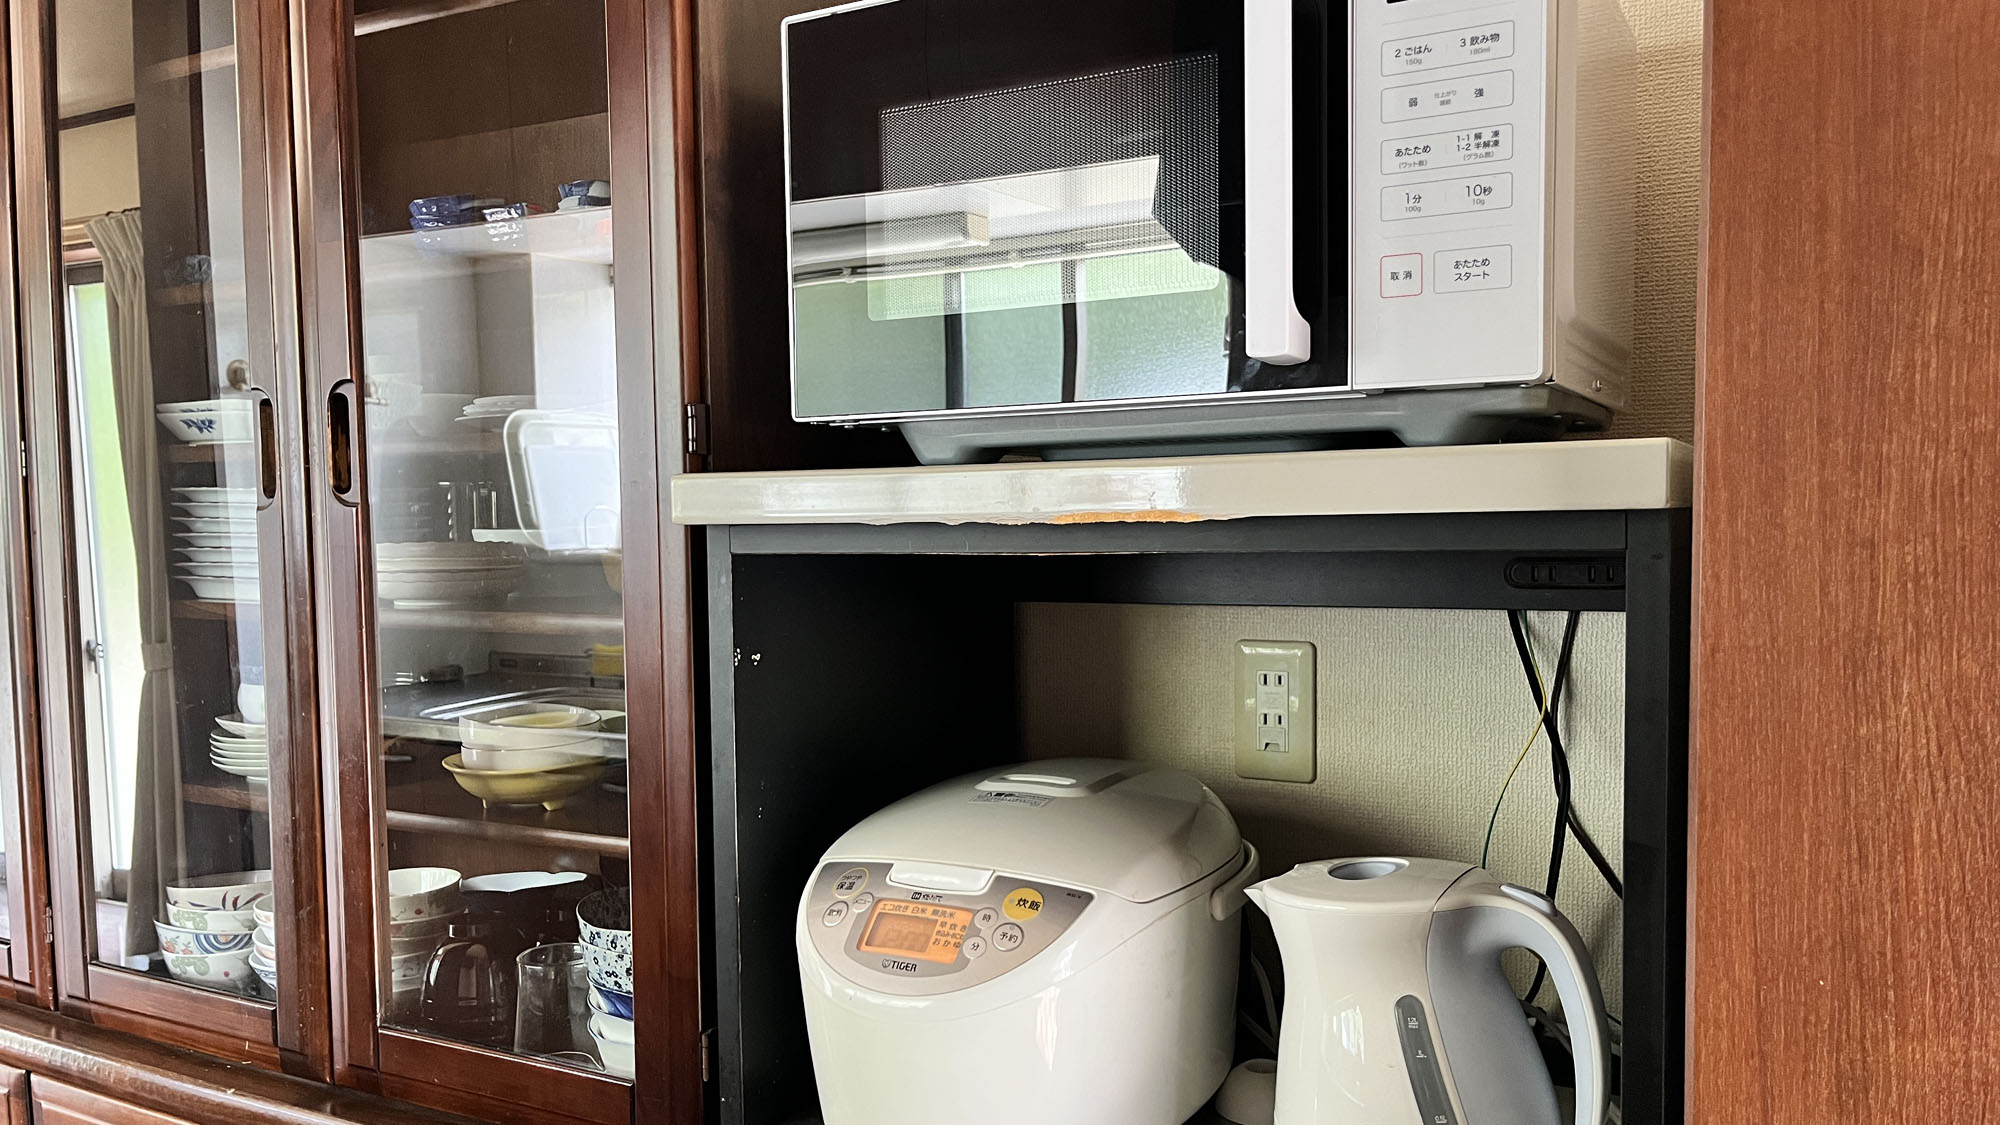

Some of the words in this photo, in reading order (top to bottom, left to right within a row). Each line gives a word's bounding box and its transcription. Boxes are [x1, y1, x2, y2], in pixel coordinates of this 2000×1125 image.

[1460, 38, 1466, 47] 3
[1470, 33, 1500, 46] 飲み物
[1395, 48, 1401, 58] 2
[1405, 44, 1432, 57] ごはん
[1405, 58, 1422, 66] 150g
[1474, 88, 1484, 97] 強
[1408, 97, 1418, 107] 弱
[1457, 134, 1470, 143] 1-1
[1394, 145, 1432, 158] あたため
[1457, 143, 1471, 152] 1-2
[1474, 139, 1500, 150] 半解凍
[1466, 184, 1493, 197] 10秒
[1405, 192, 1422, 205] 1分
[1472, 198, 1485, 207] 10g
[1405, 205, 1422, 214] 100g
[1453, 257, 1491, 270] あたため
[1454, 270, 1490, 282] スタート
[836, 881, 856, 890] 保温
[911, 906, 928, 914] 白米
[1015, 897, 1042, 912] 炊飯
[982, 913, 991, 922] 時
[999, 931, 1018, 943] 予約
[970, 942, 980, 951] 分
[891, 960, 918, 972] TIGER
